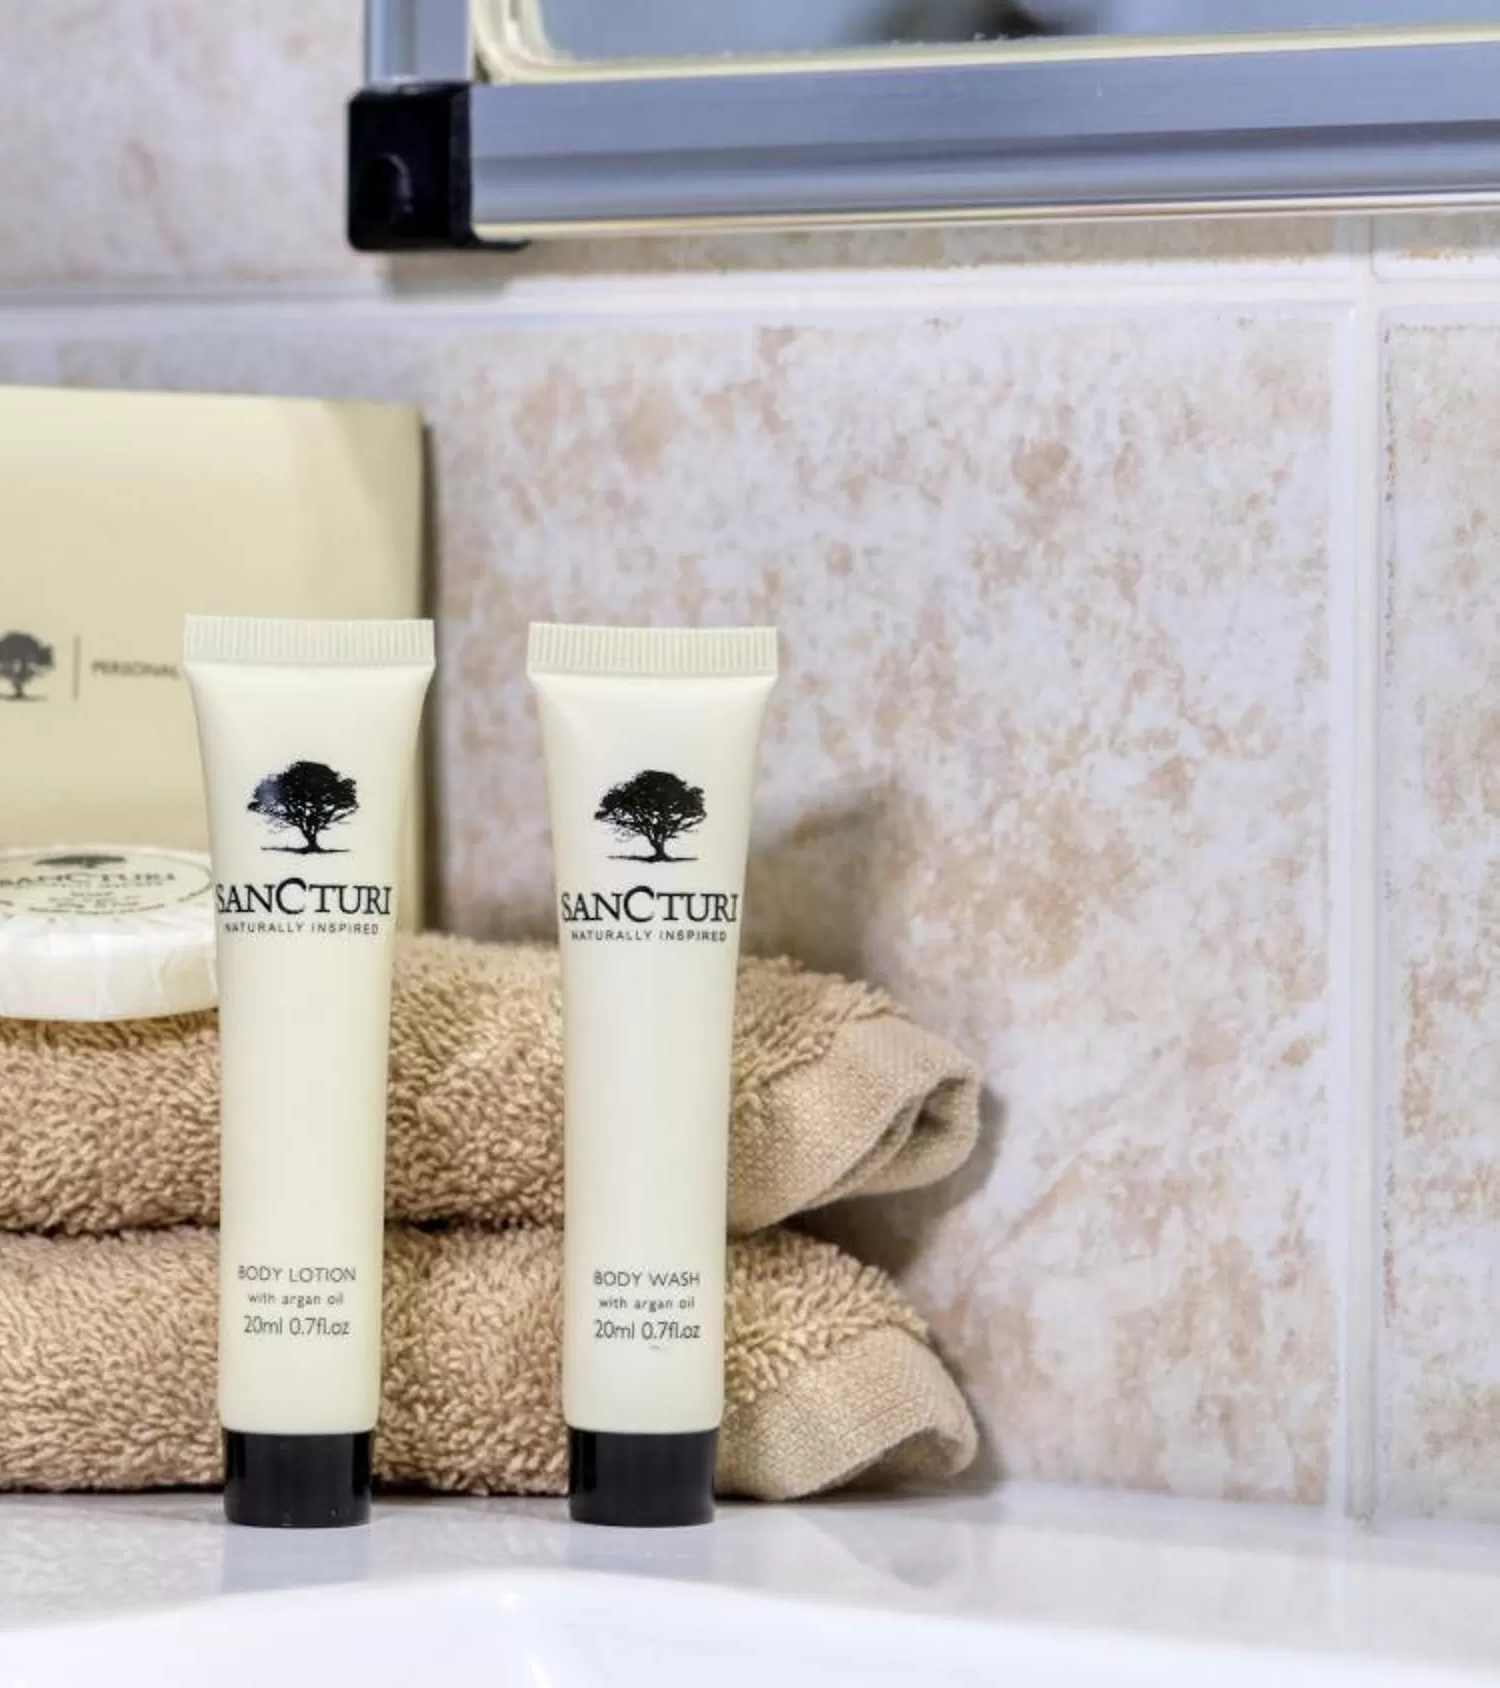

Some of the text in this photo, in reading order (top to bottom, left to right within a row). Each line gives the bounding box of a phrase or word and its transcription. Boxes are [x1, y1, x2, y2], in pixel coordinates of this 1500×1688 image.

[215, 877, 392, 915] SANCTURI
[561, 885, 739, 923] SANCTURI
[224, 921, 380, 935] NATURALLY INSPIRED
[571, 929, 727, 942] NATURALLY INSPIRED
[237, 1264, 356, 1283] BODY LOTION
[593, 1270, 701, 1287] BODY WASH
[248, 1291, 344, 1308] with argan oil
[598, 1296, 695, 1312] with argan oil
[243, 1315, 283, 1335] 20ml
[594, 1319, 634, 1340] 20ml
